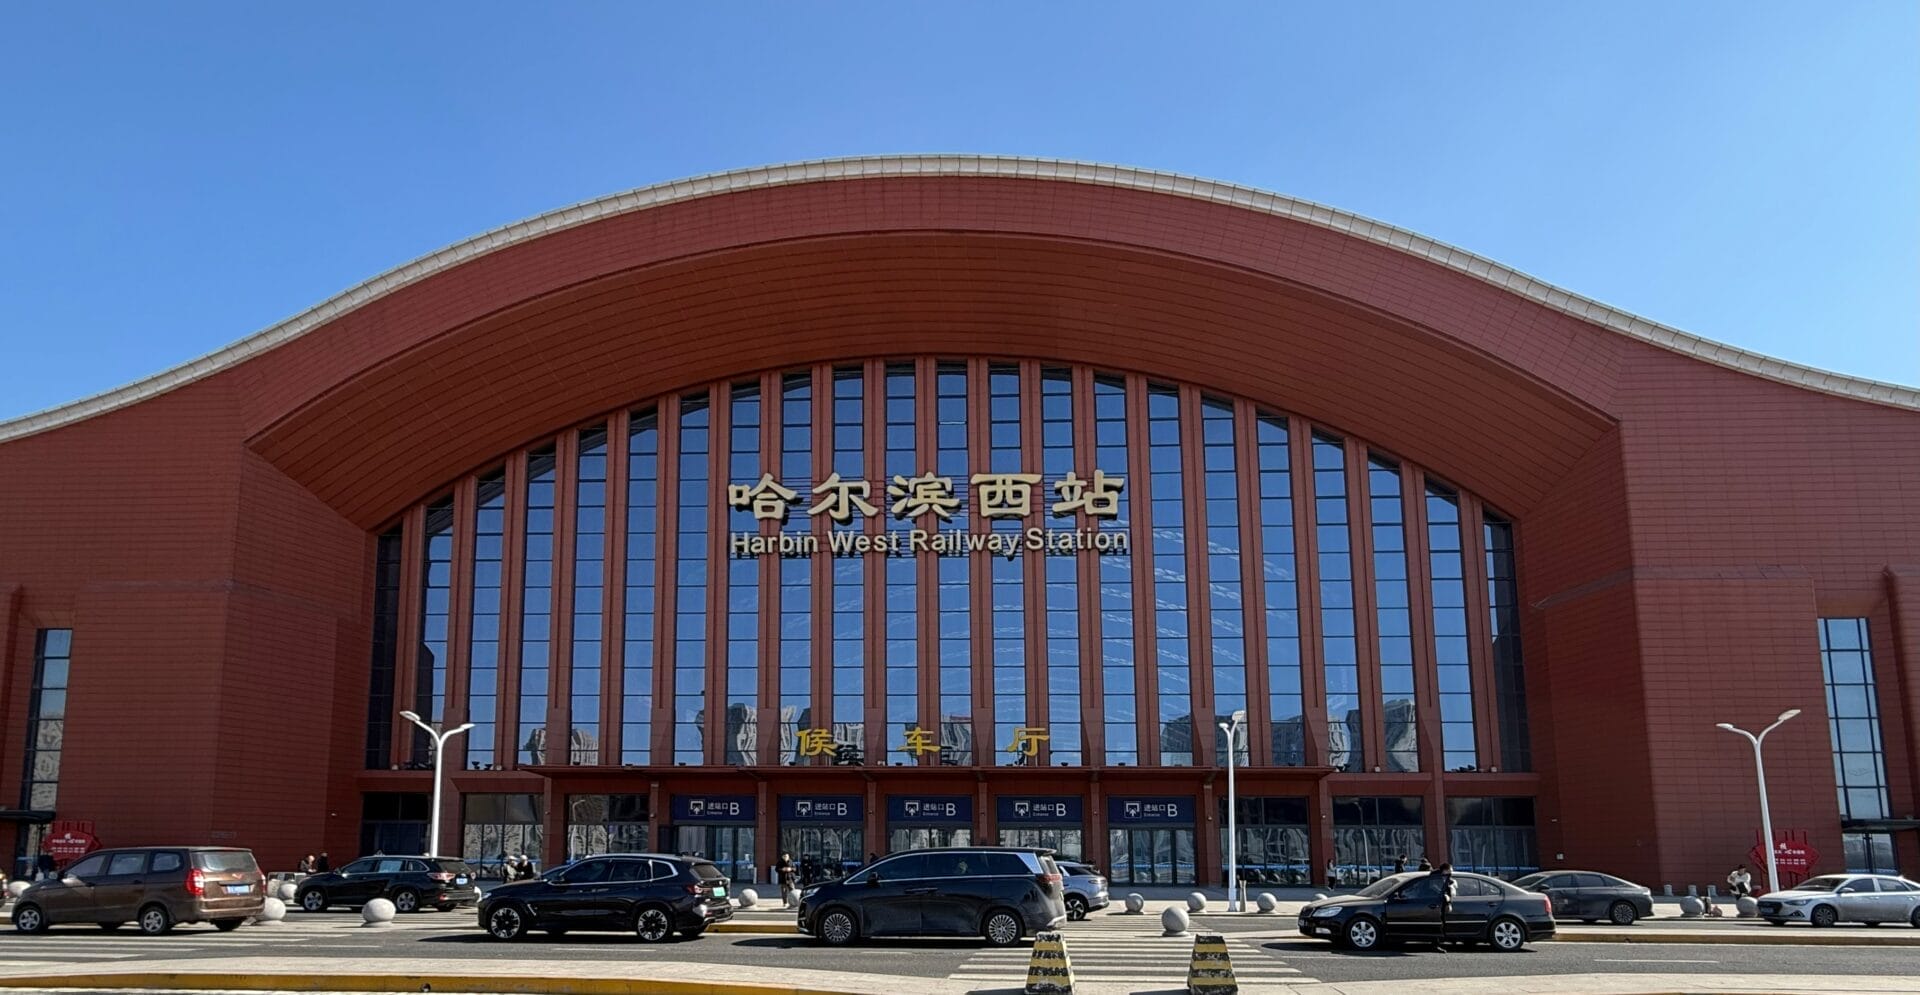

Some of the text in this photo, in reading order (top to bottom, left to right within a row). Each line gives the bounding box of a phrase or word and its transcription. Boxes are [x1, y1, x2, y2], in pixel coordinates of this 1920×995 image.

[728, 469, 1125, 520] 哈尔滨西站
[731, 527, 1128, 556] Harbin West Railway Station
[795, 727, 1050, 757] 候车厅
[730, 802, 740, 816] B
[837, 802, 848, 816] B
[945, 802, 956, 816] B
[1055, 803, 1067, 817] B
[1167, 803, 1178, 817] B
